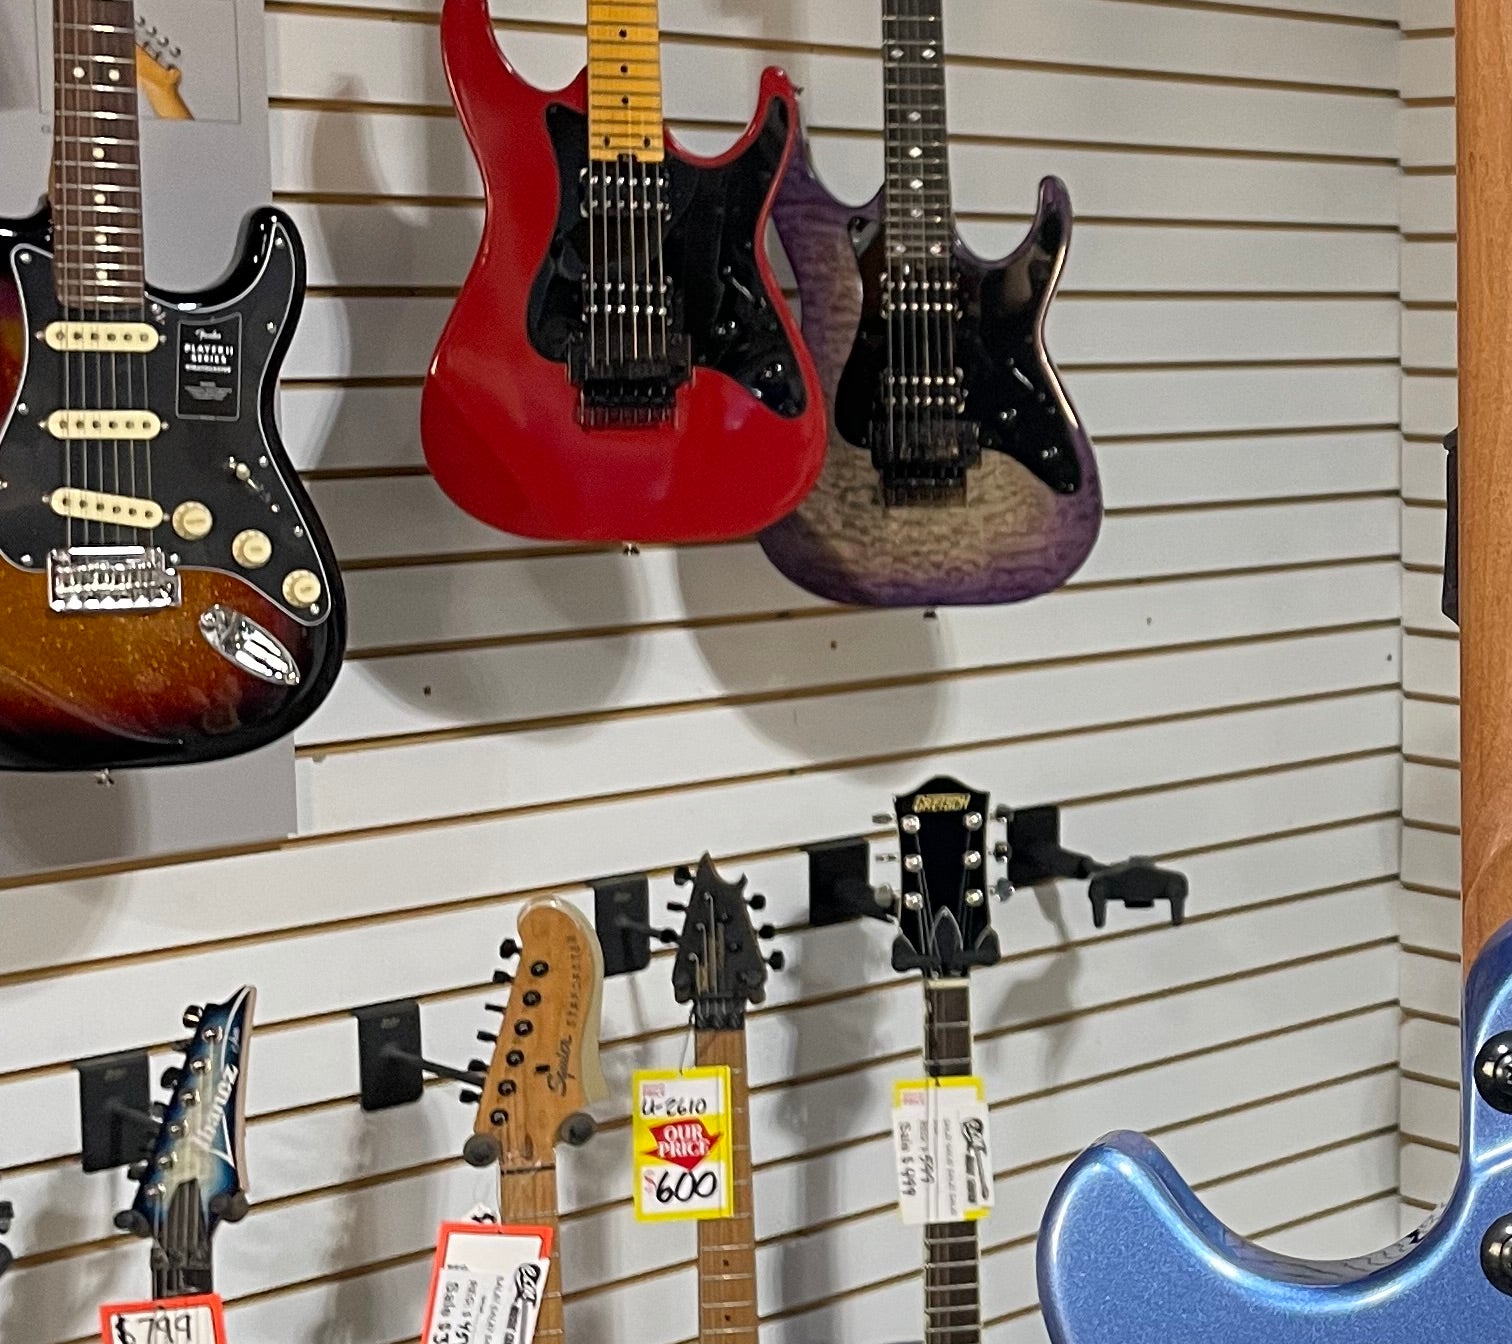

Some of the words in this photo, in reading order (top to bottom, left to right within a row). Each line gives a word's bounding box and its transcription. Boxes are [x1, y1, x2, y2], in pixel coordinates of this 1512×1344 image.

[662, 1124, 703, 1142] OUR
[657, 1140, 712, 1158] PRICE
[643, 1167, 718, 1204] $600
